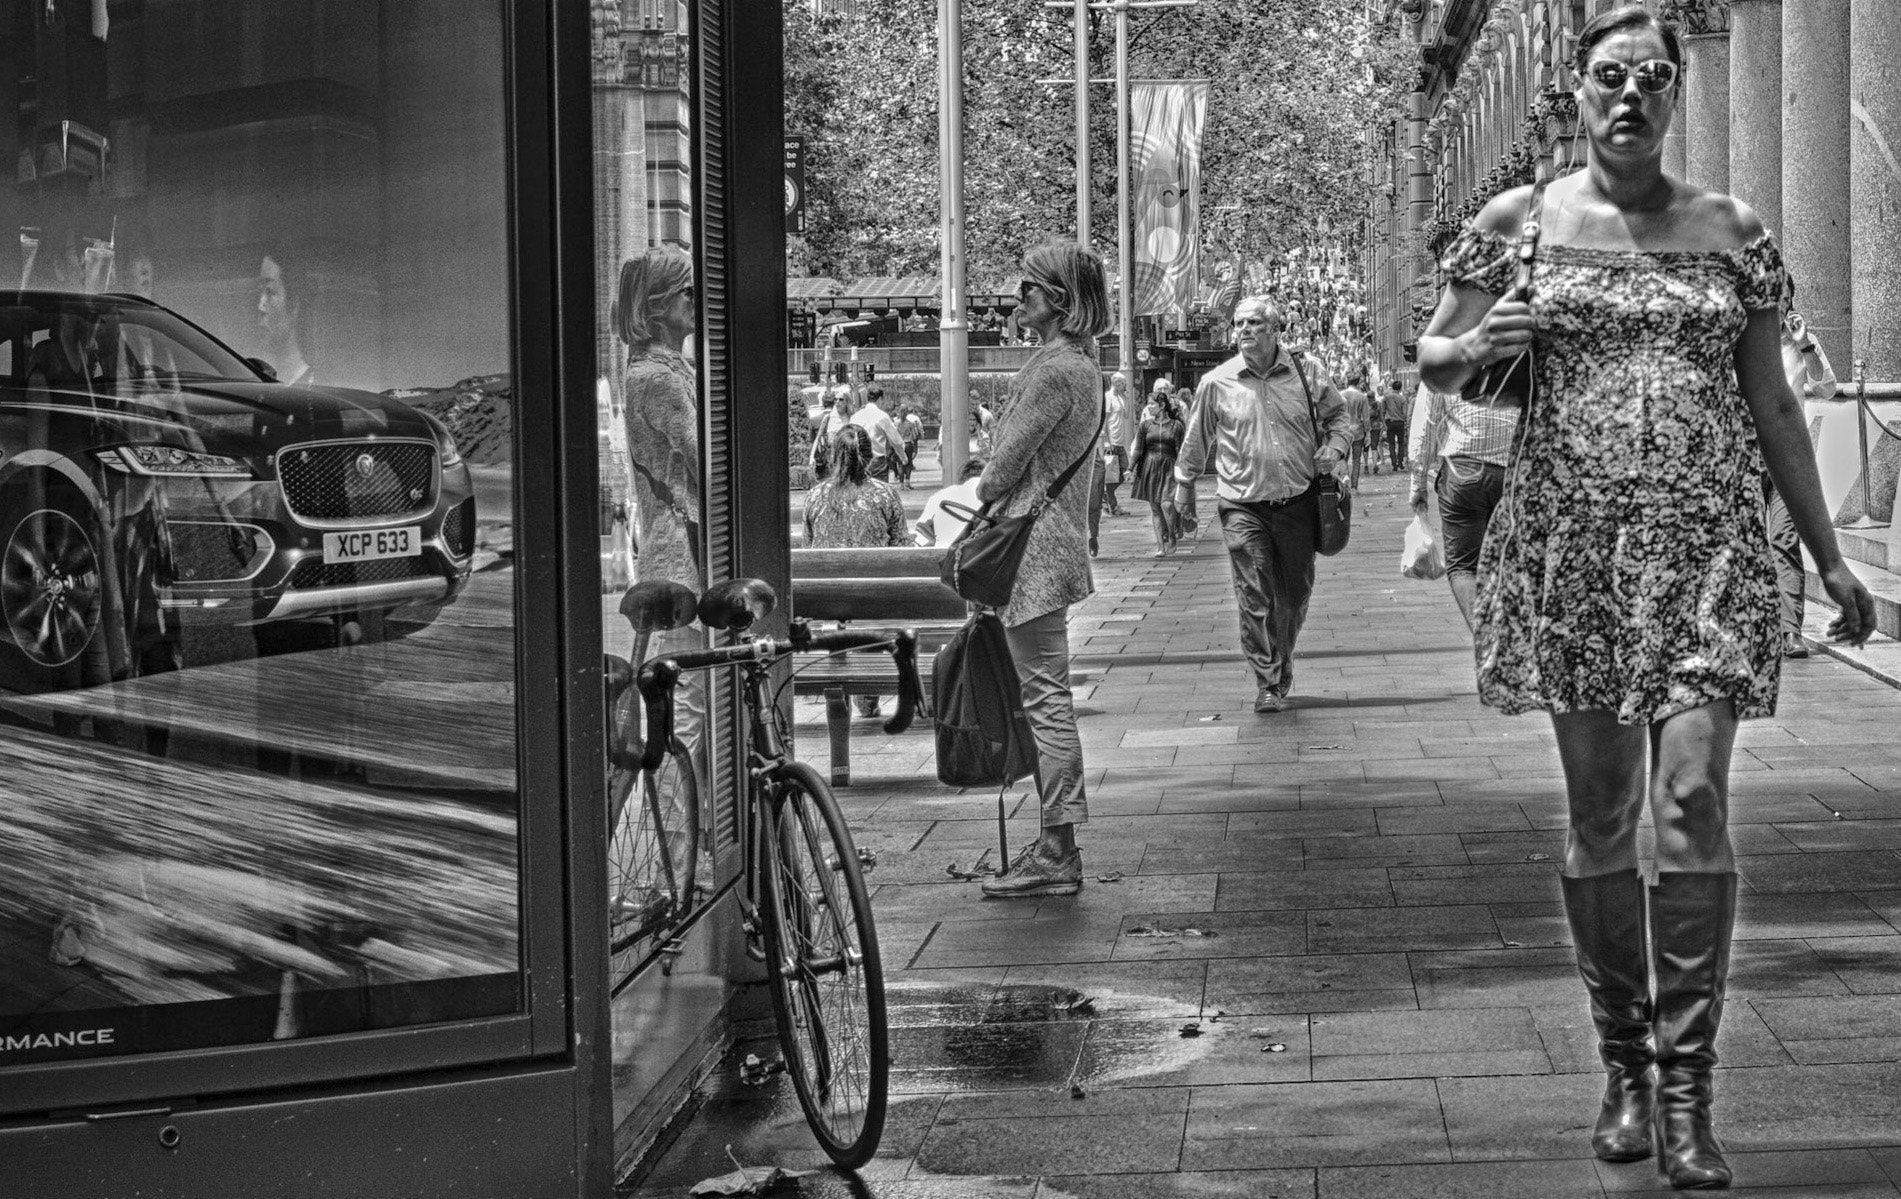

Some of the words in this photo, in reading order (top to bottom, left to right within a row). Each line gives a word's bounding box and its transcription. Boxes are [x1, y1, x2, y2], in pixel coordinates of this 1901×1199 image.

[786, 151, 797, 159] be
[338, 533, 372, 557] XCP
[377, 530, 409, 554] 633
[0, 1027, 115, 1052] MANCE
